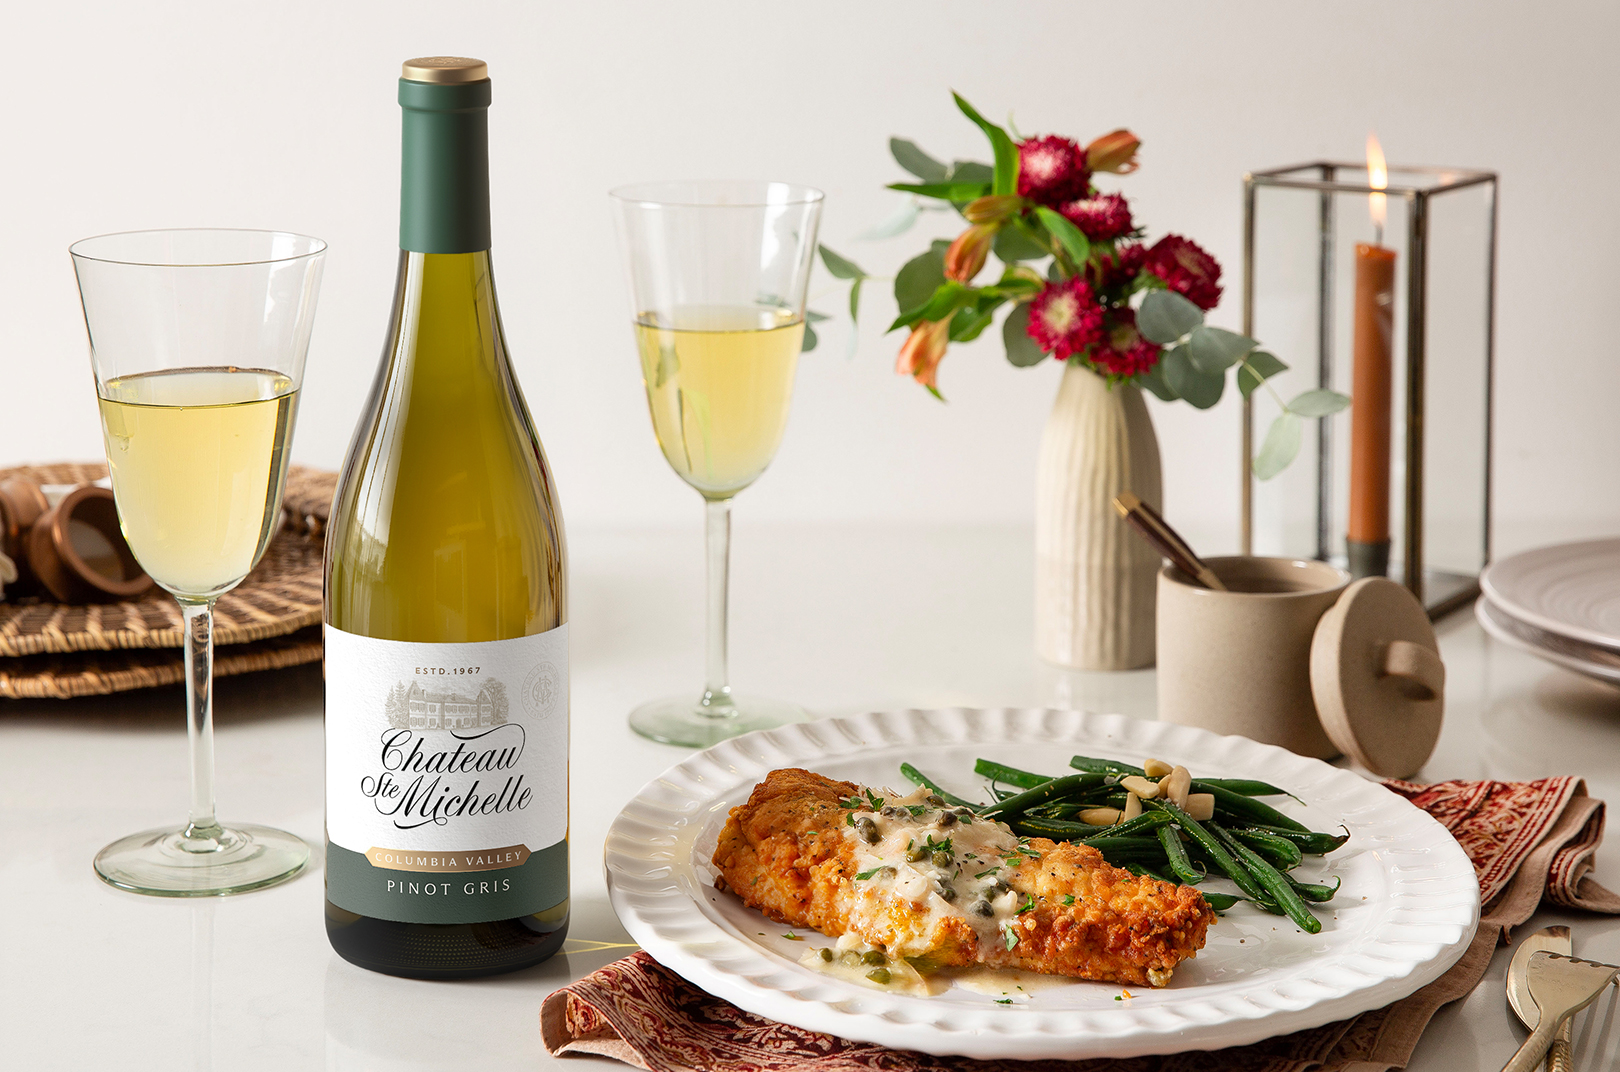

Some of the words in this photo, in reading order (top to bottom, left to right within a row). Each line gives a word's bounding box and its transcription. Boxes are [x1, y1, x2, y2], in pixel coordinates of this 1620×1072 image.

[415, 666, 481, 676] ESTD.1967
[380, 723, 526, 774] Chateau
[360, 771, 401, 799] Ste
[374, 774, 533, 830] Michelle
[375, 852, 458, 867] COLUMBIA
[466, 850, 523, 866] VALLEY
[386, 879, 452, 896] PINOT
[463, 878, 511, 895] GRIS
